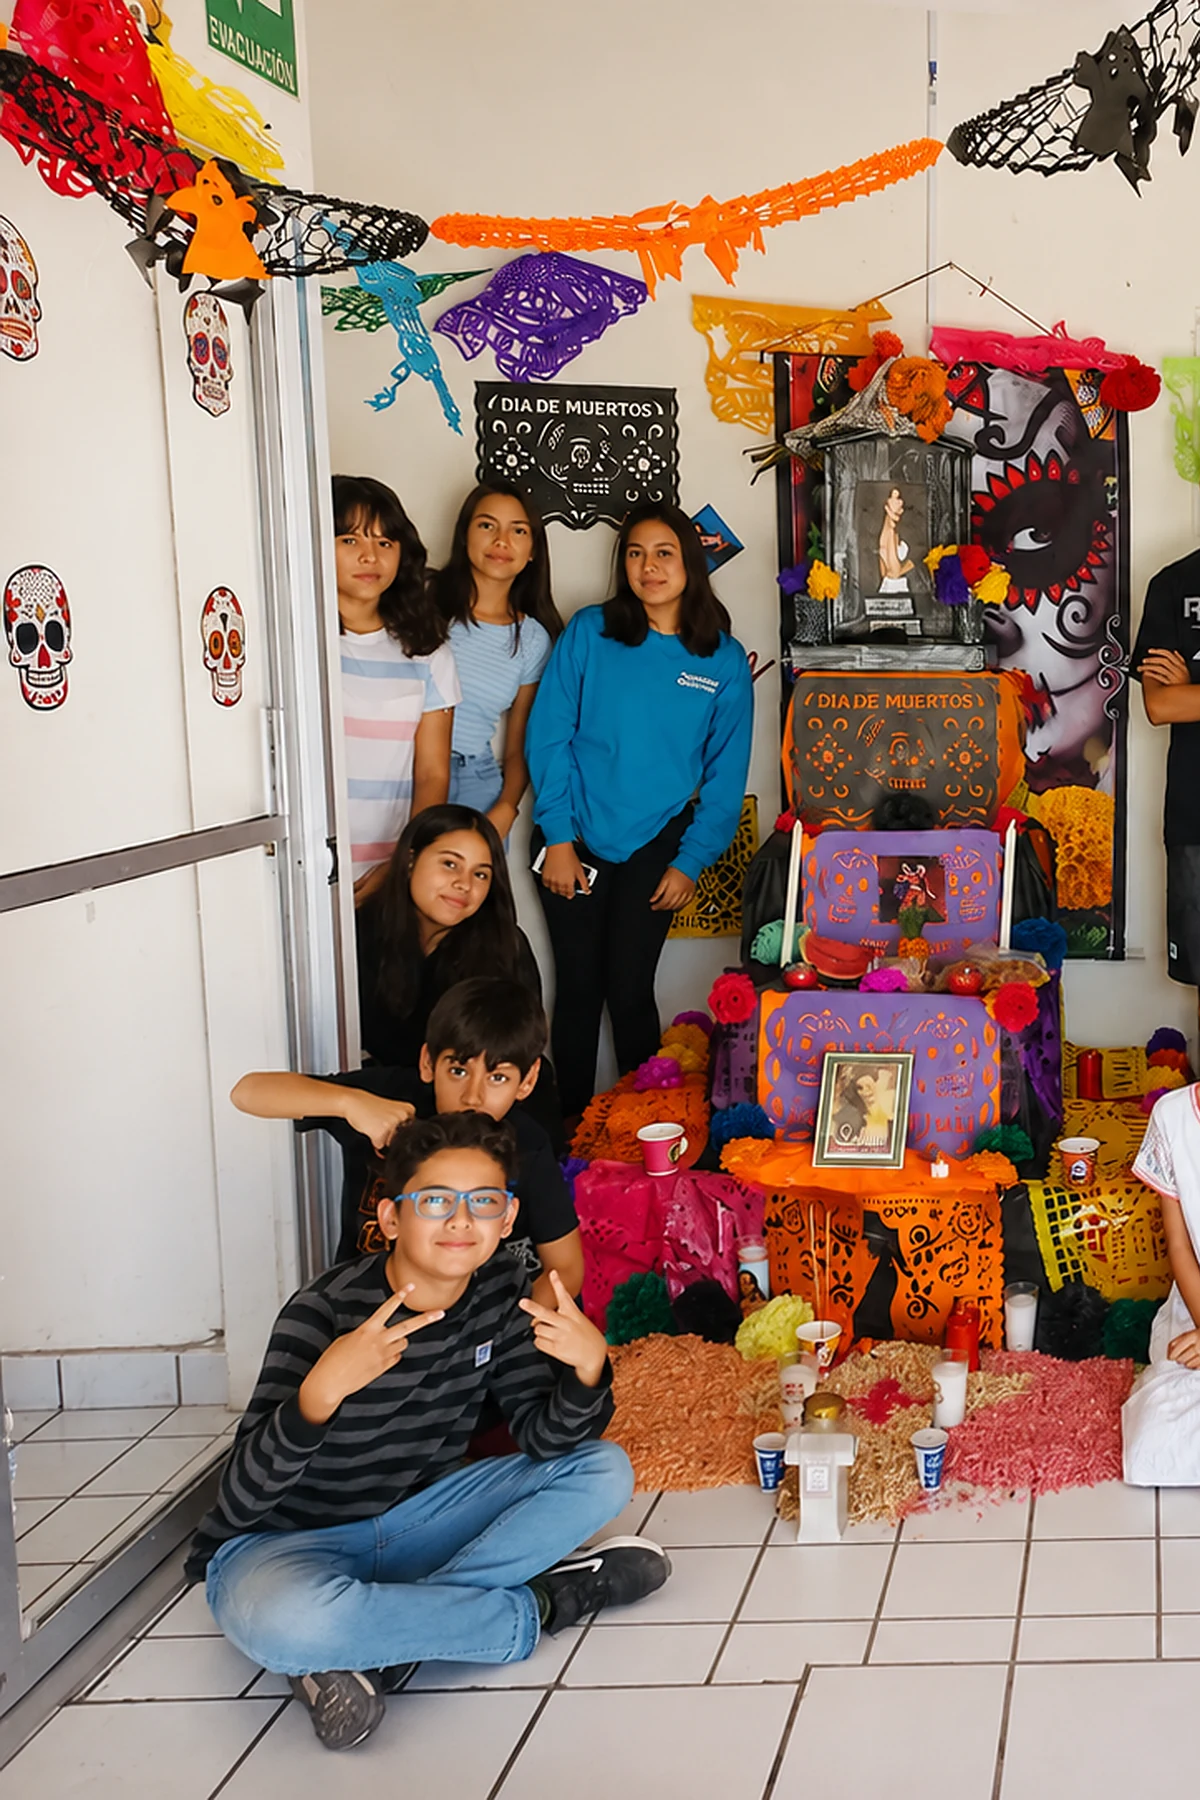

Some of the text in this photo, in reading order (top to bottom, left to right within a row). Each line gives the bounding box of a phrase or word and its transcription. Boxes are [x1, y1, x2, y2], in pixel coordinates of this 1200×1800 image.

[501, 397, 652, 417] DIA DE MUERTOS
[817, 693, 973, 709] DIA DE MUERTOS
